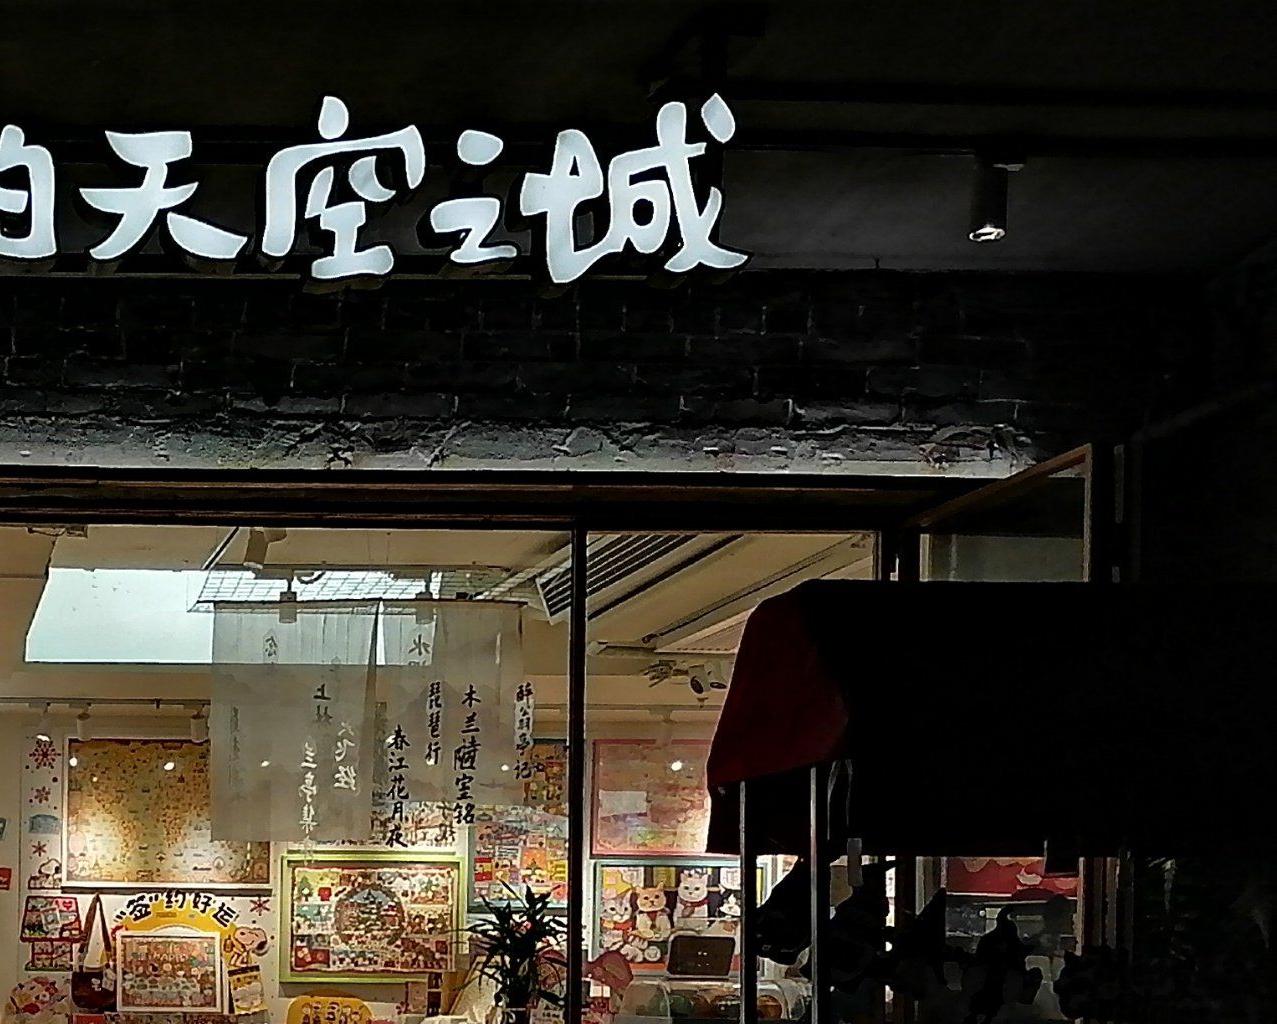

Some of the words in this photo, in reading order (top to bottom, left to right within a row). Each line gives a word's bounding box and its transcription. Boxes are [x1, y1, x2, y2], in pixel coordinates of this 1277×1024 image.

[425, 681, 442, 765] 琵琶行
[385, 724, 410, 848] 春江花月夜
